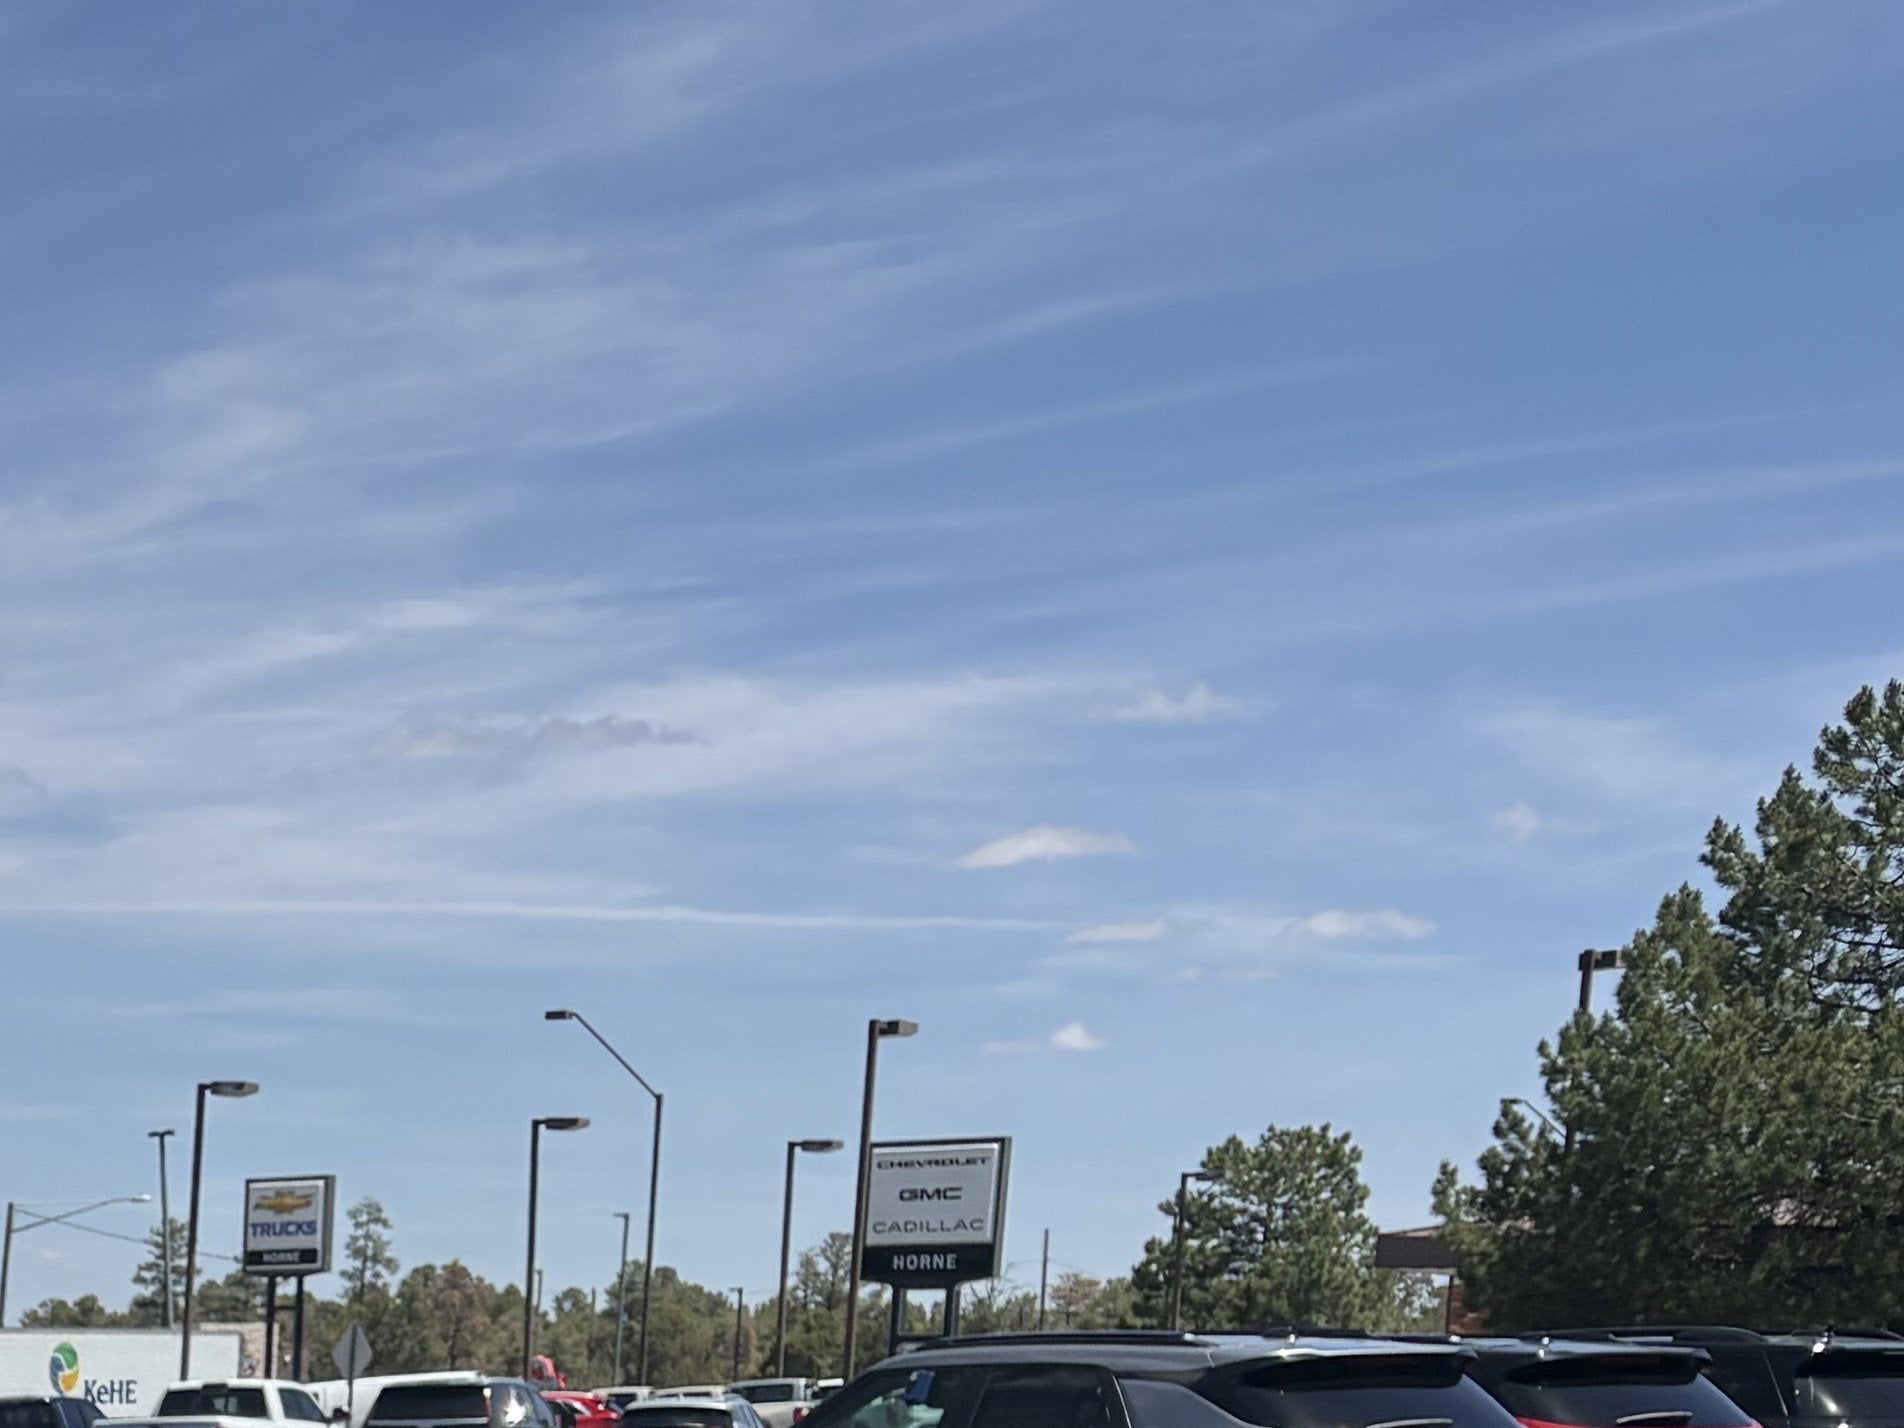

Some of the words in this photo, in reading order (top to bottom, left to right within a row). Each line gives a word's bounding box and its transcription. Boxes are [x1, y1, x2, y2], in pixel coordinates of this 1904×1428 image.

[877, 1156, 990, 1170] CHEVROLET
[899, 1186, 963, 1202] GMC
[250, 1220, 318, 1238] TRUCKS
[872, 1217, 985, 1235] CADILLAC
[893, 1253, 958, 1271] HORNE
[84, 1379, 138, 1405] KeHE
